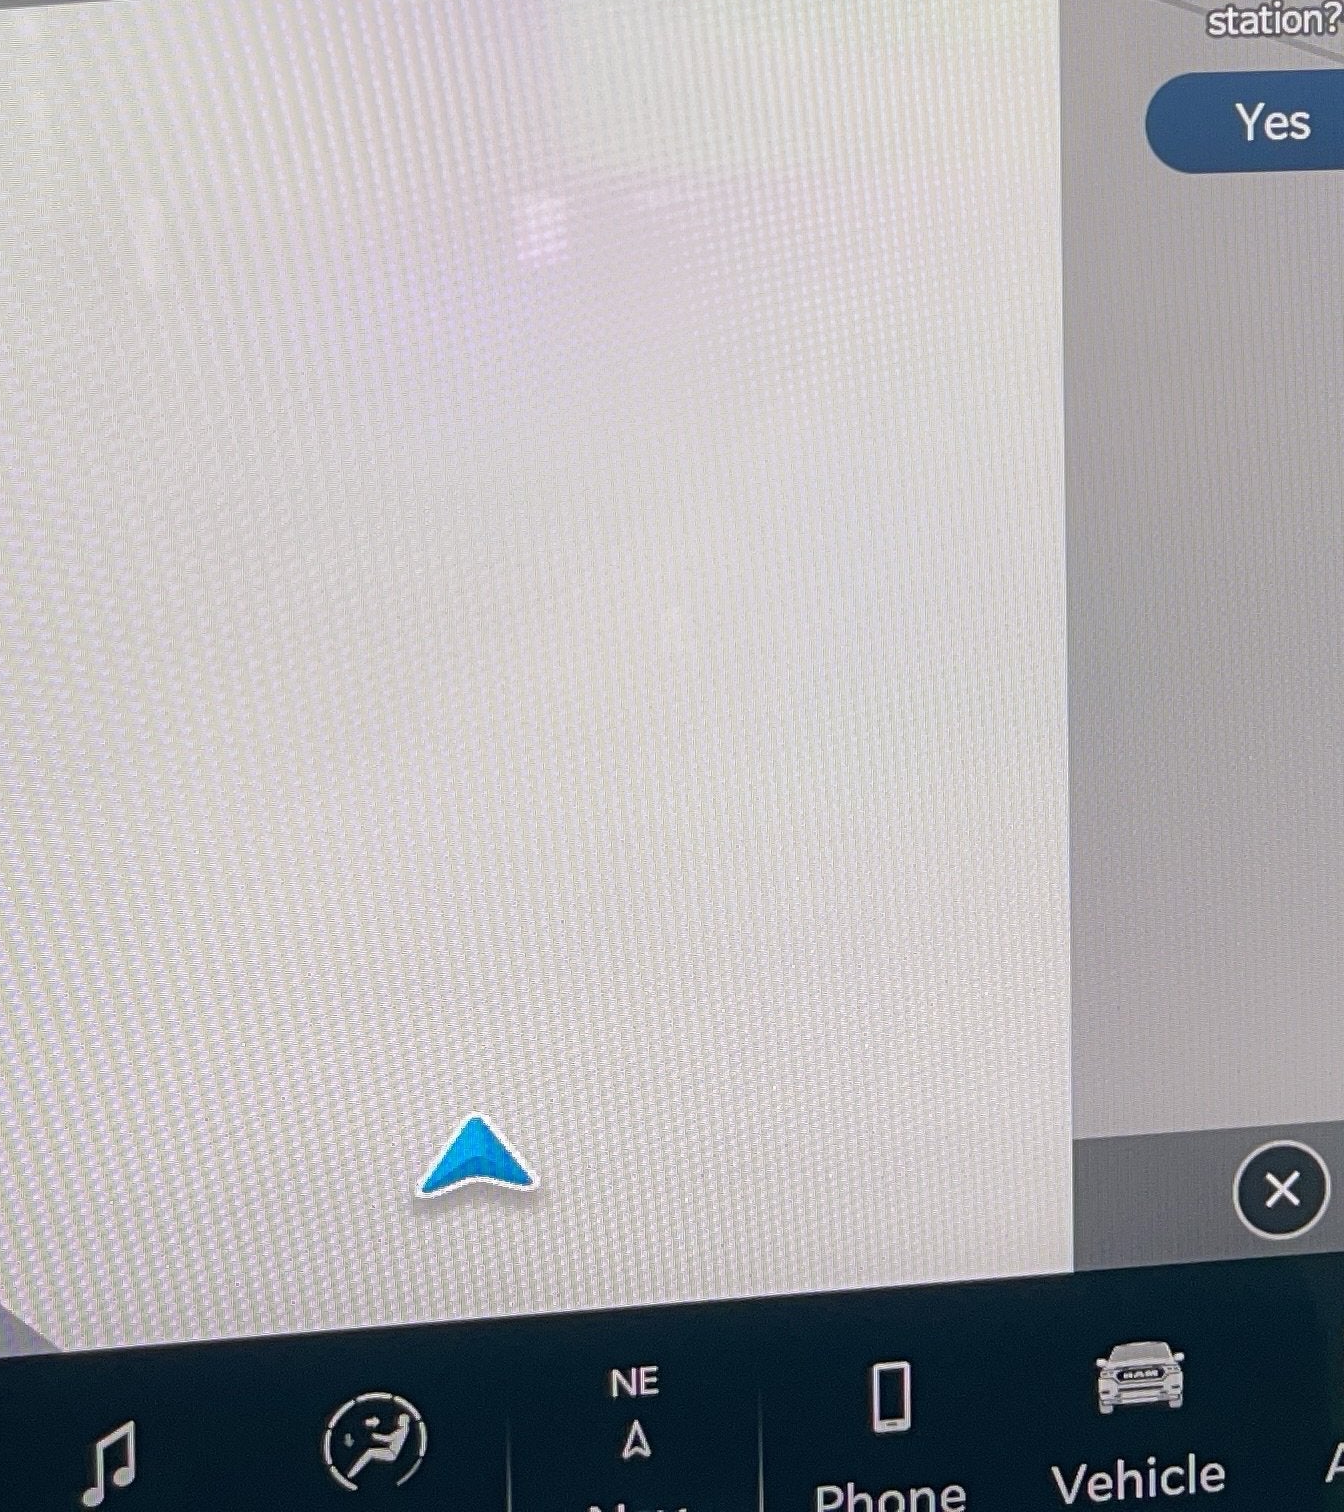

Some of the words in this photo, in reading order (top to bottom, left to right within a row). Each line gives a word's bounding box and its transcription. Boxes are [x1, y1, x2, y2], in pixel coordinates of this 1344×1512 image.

[1207, 1, 1344, 36] station?
[1235, 102, 1312, 141] Yes
[610, 1365, 660, 1398] NE
[1050, 1452, 1227, 1505] Vehicle
